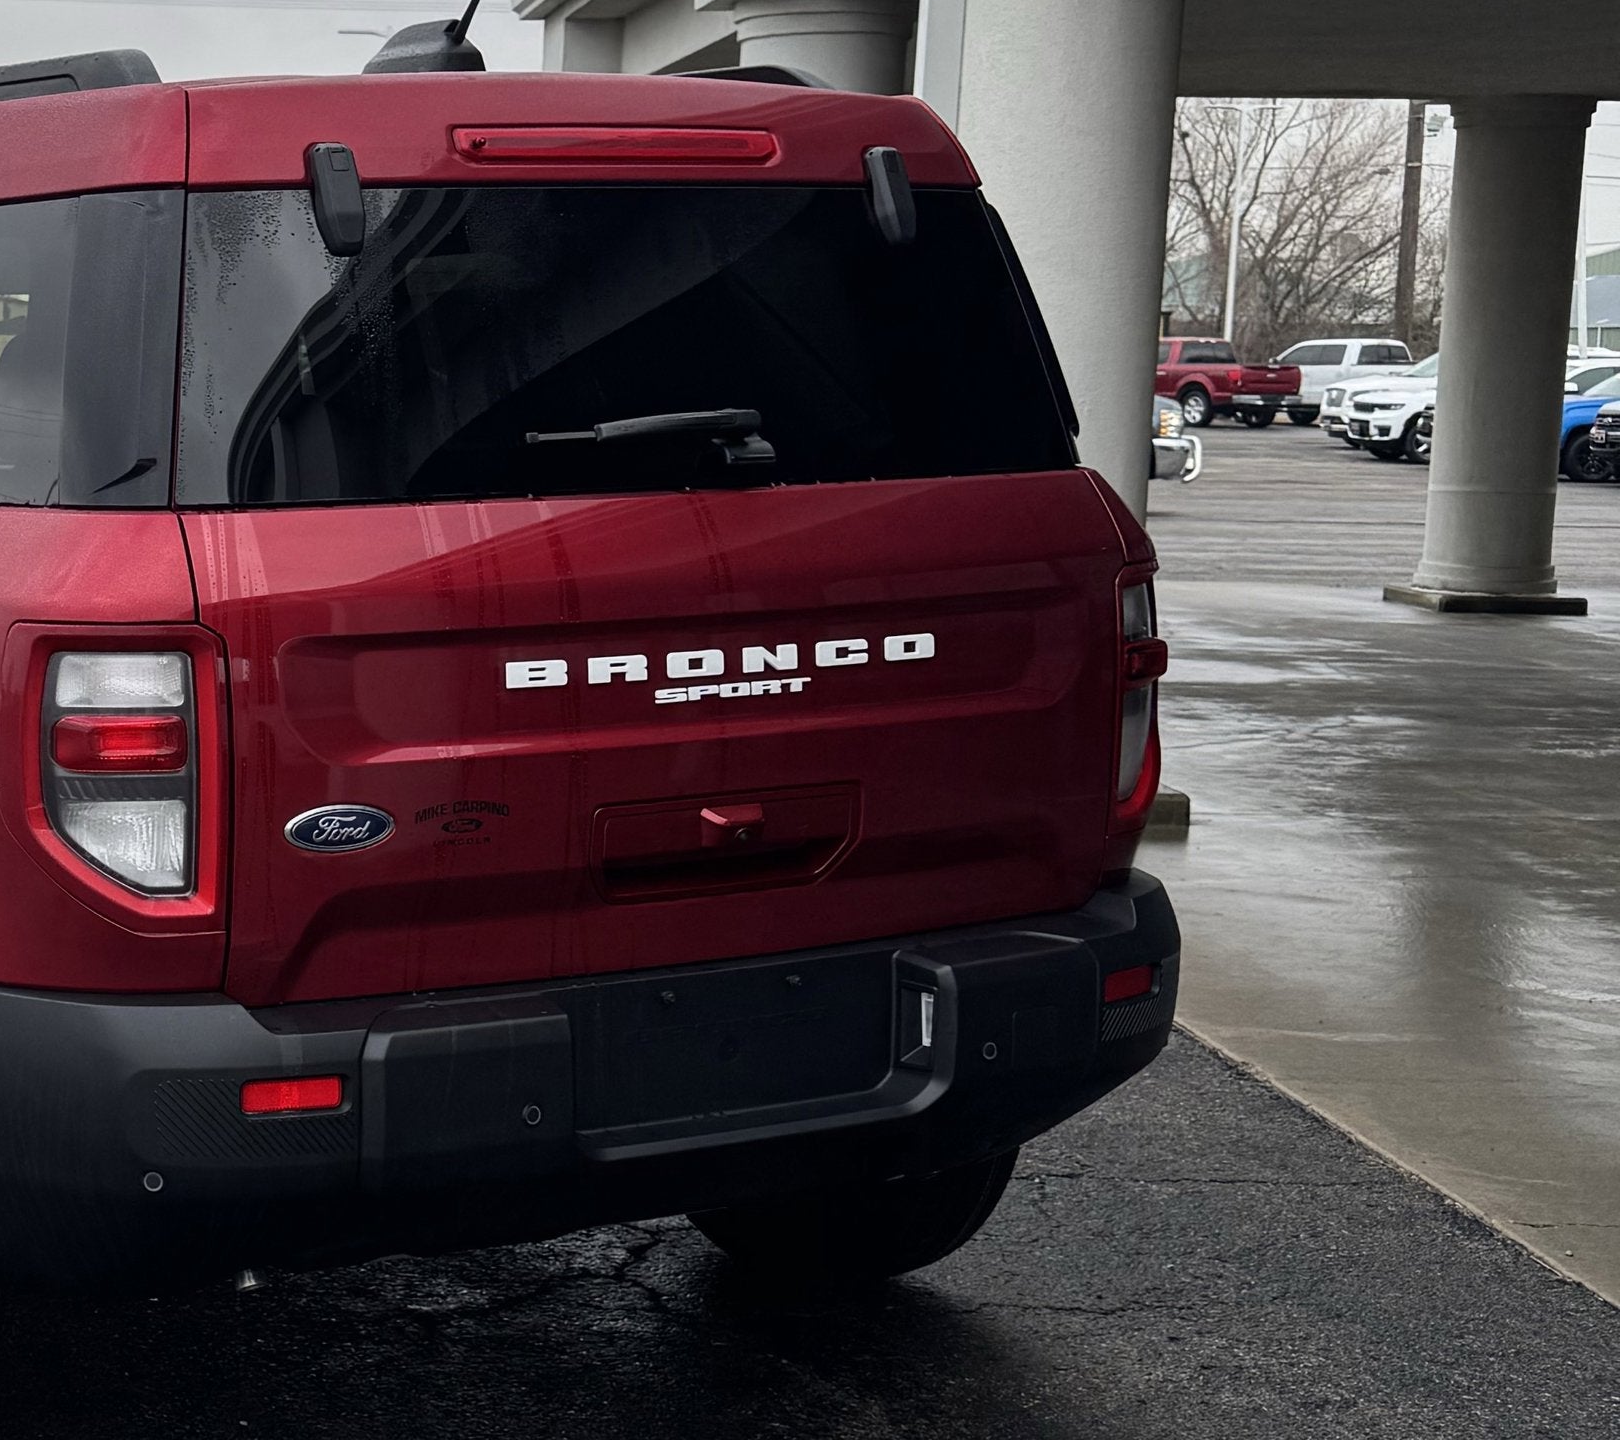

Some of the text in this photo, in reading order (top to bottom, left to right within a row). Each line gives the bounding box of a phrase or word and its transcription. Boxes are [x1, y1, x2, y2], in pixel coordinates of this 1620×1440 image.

[505, 633, 935, 689] BRONCO
[654, 677, 811, 704] SPORT
[414, 803, 448, 824] MIKE
[312, 815, 371, 841] Ford
